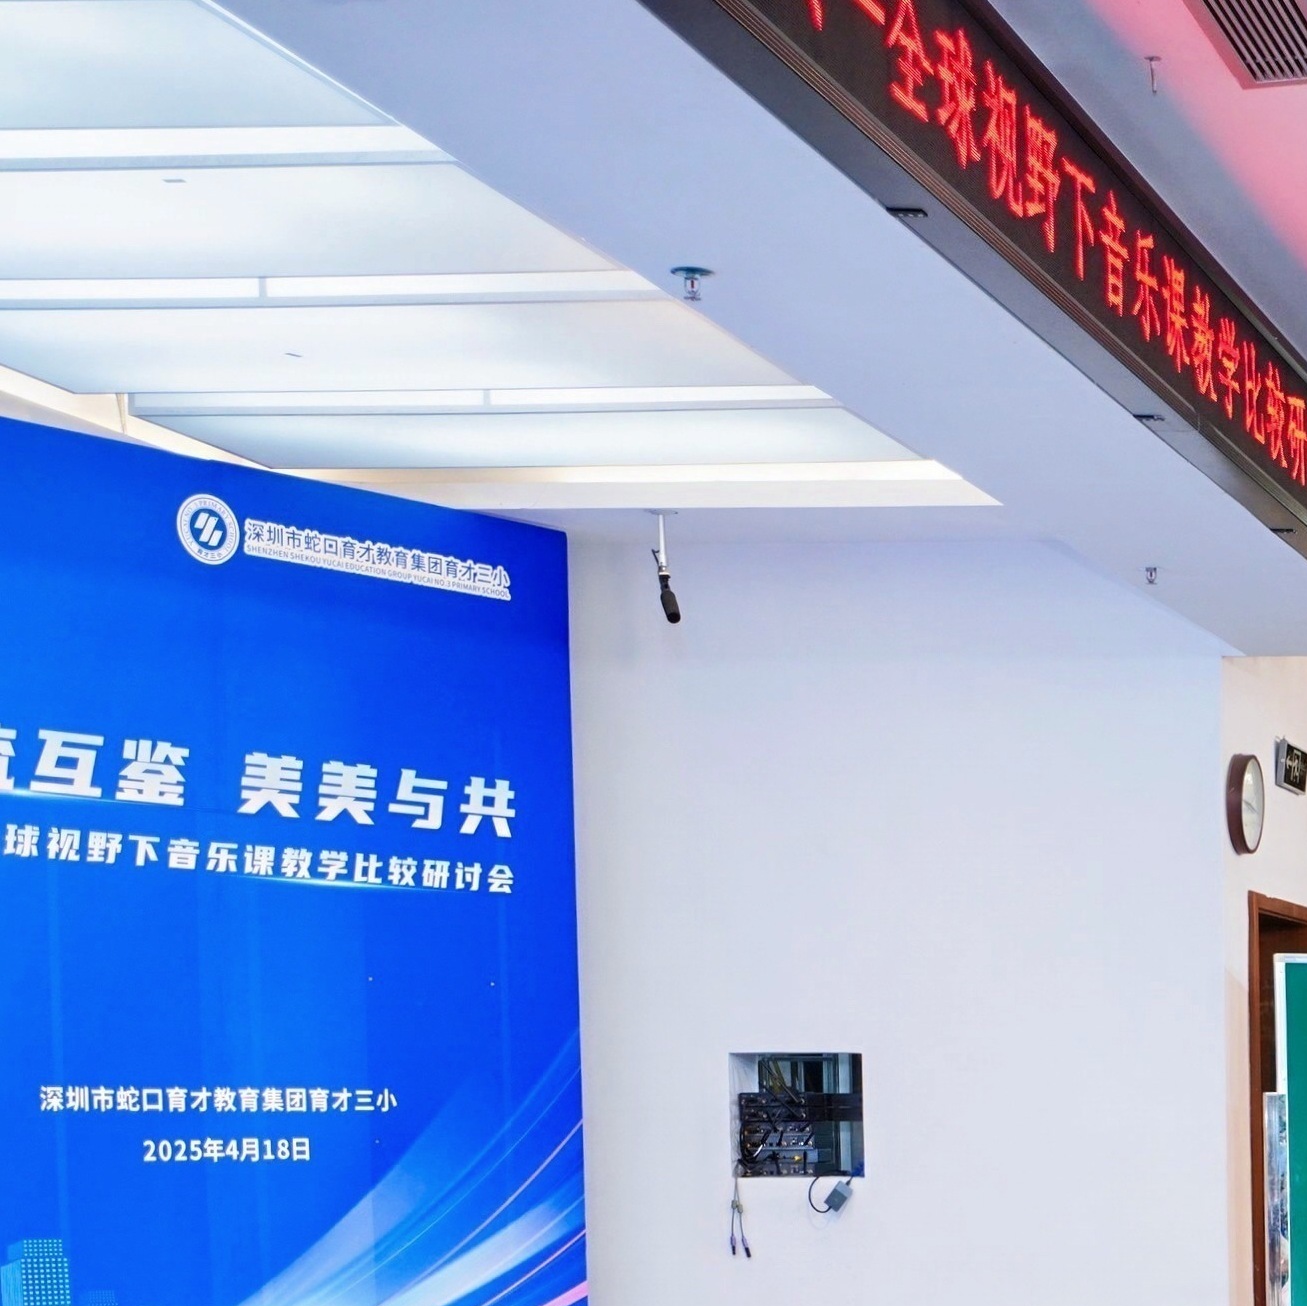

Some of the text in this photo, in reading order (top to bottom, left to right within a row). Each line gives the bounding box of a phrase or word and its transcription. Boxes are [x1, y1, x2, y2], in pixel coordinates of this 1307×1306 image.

[247, 545, 288, 558] SHENZHEN
[290, 551, 321, 564] SHEKOU
[323, 557, 343, 568] YUCAI
[345, 563, 386, 575] EDUCATION
[388, 570, 412, 580] GROUP
[413, 575, 433, 584] YUCAI
[452, 582, 481, 593] PRIMARY
[482, 587, 509, 598] SCHOOL
[248, 521, 509, 588] 深圳市蛇口育才教育集团育才三小
[0, 723, 516, 838] 互鉴 美美与共
[2, 823, 515, 894] 球视野下音乐课教学比较研讨会
[40, 1085, 398, 1113] 深圳市蛇口育才教育集团育才三小
[143, 1137, 311, 1162] 2025年4月18日
